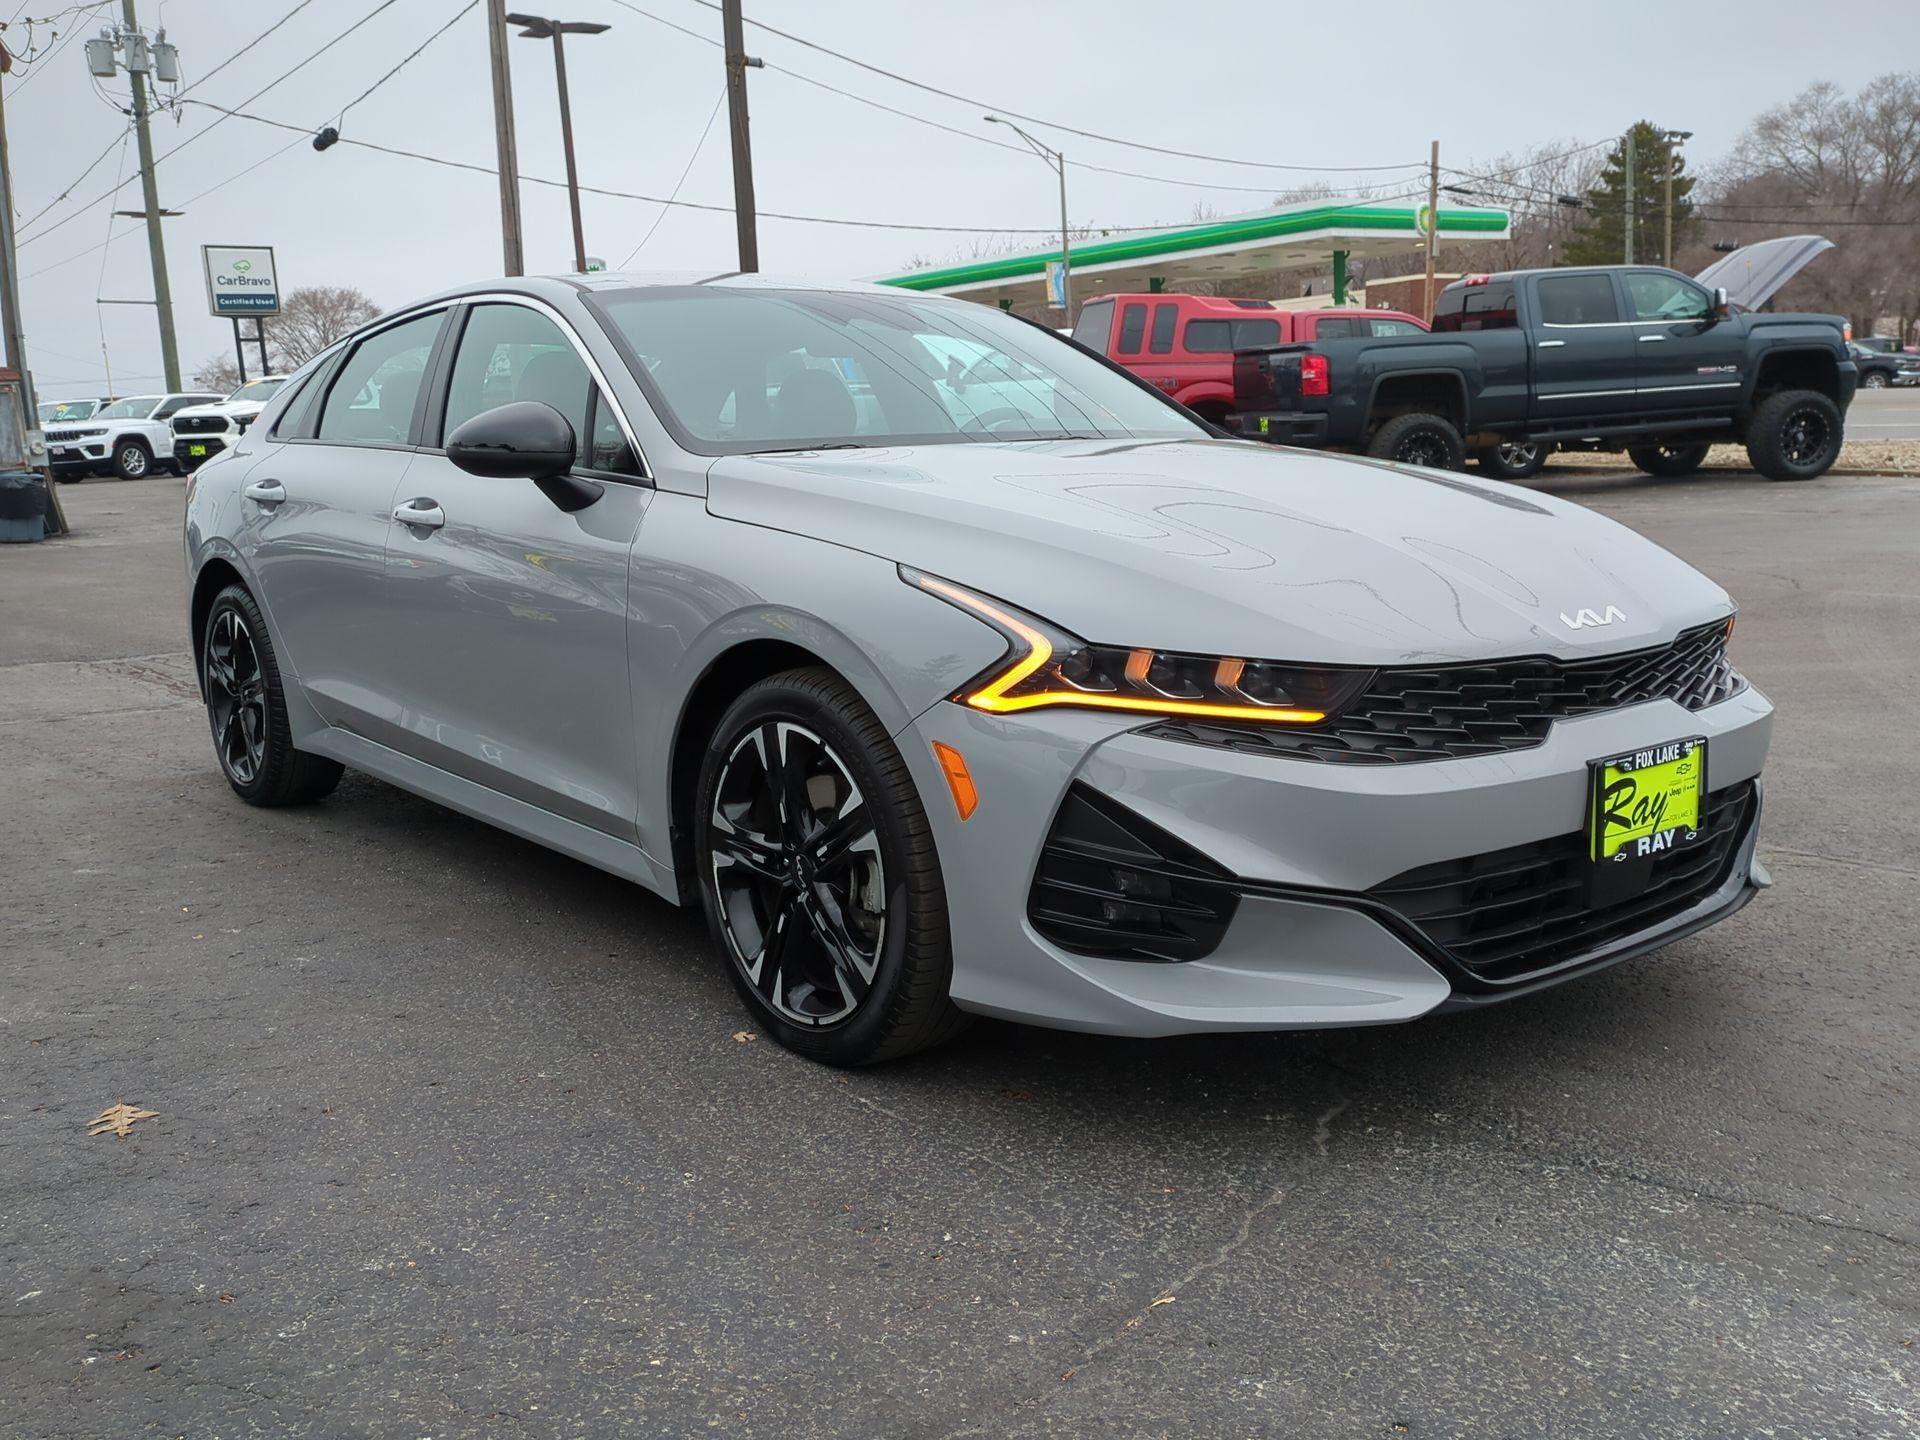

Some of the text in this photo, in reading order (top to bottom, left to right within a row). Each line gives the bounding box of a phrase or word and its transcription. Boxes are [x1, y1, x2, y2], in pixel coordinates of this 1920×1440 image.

[217, 275, 271, 286] CarBravo
[1560, 605, 1627, 630] KIA
[1635, 743, 1680, 770] FOX LAKE
[1604, 777, 1669, 834] Ray
[1638, 828, 1676, 857] RAY
